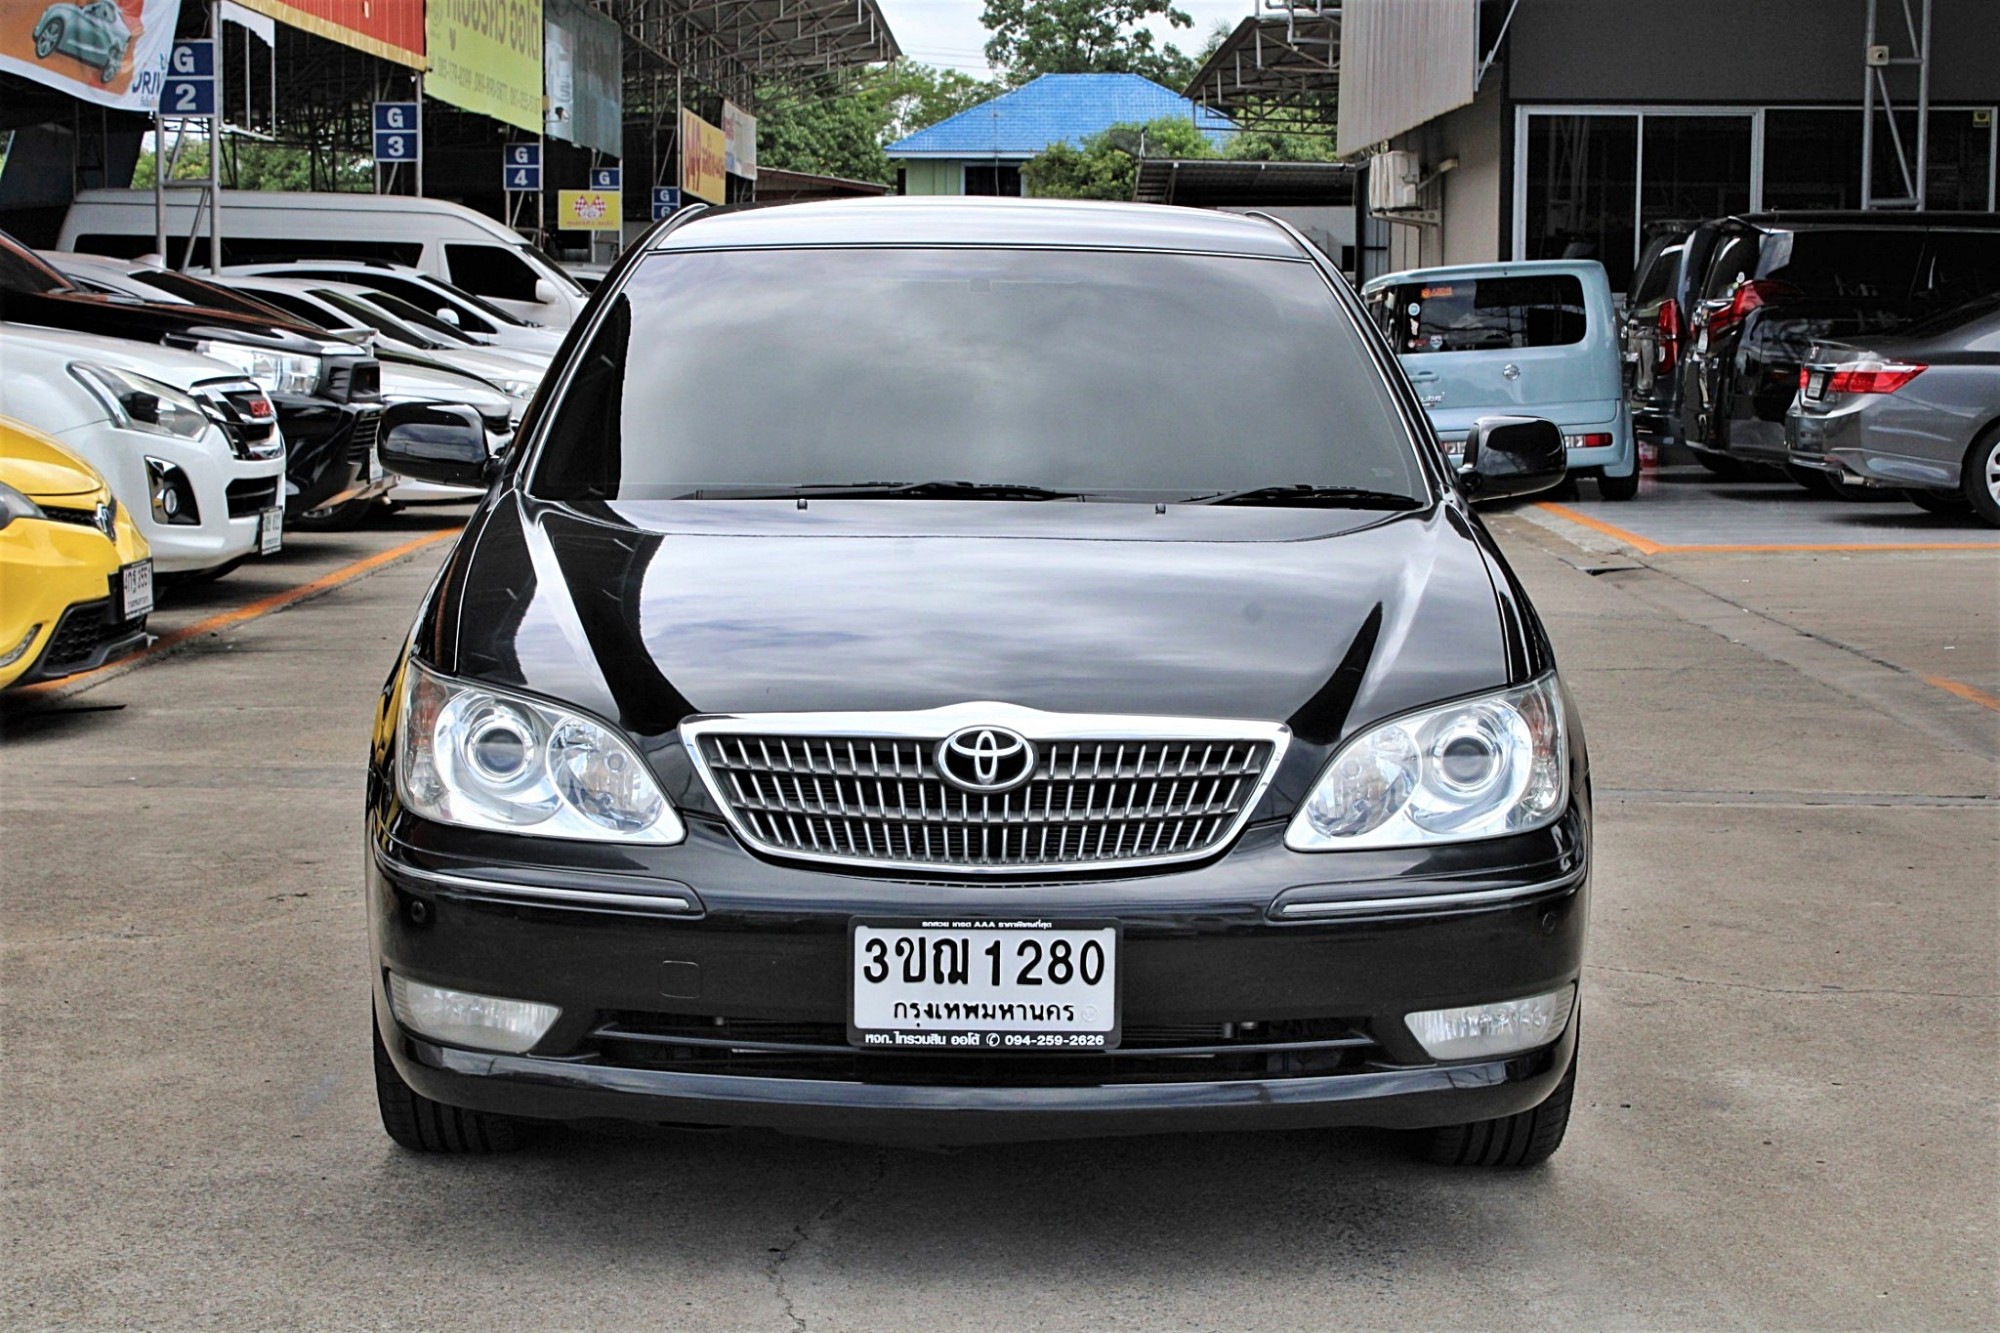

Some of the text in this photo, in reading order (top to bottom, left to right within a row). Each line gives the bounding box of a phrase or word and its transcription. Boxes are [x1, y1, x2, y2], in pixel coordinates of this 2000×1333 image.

[173, 46, 195, 73] G
[175, 83, 197, 111] 2
[387, 107, 404, 128] G
[387, 136, 404, 157] 3
[514, 146, 528, 164] G
[513, 169, 528, 186] 4
[598, 171, 611, 185] G
[660, 189, 670, 202] G
[863, 936, 1105, 986] 3ขฌ 1280
[894, 1002, 1074, 1028] กรุงเทพมหานคร
[865, 1033, 893, 1044] หจก.
[1004, 1034, 1105, 1047] 094-259-2626
